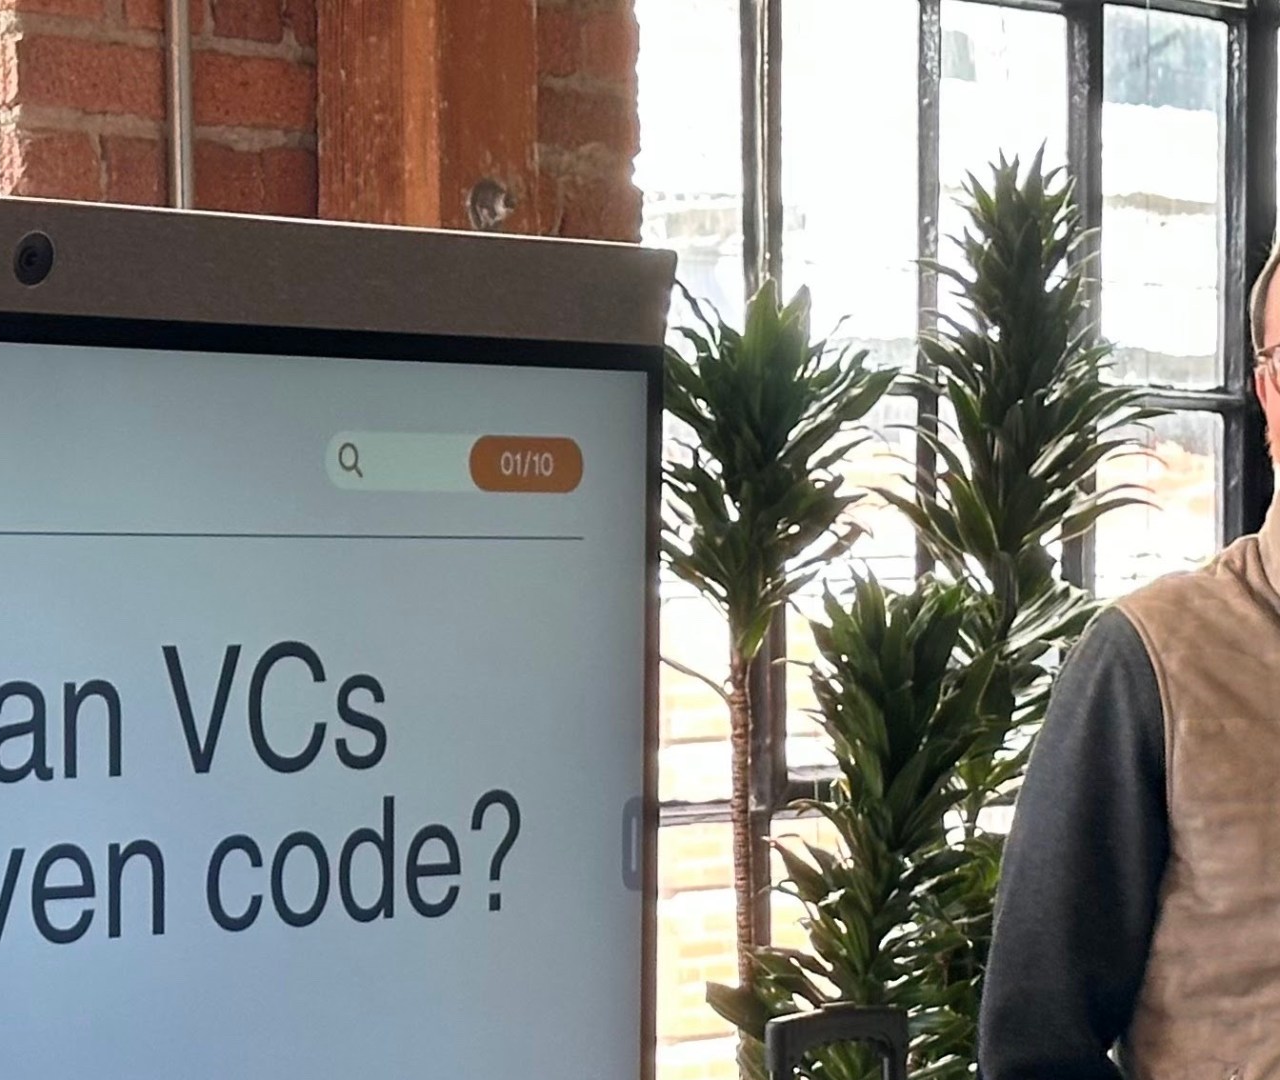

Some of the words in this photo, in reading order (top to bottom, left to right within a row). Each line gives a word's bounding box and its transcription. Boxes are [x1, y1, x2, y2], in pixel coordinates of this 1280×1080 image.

[500, 450, 554, 478] 01/10
[161, 640, 388, 774] VCs
[205, 788, 522, 932] code?
